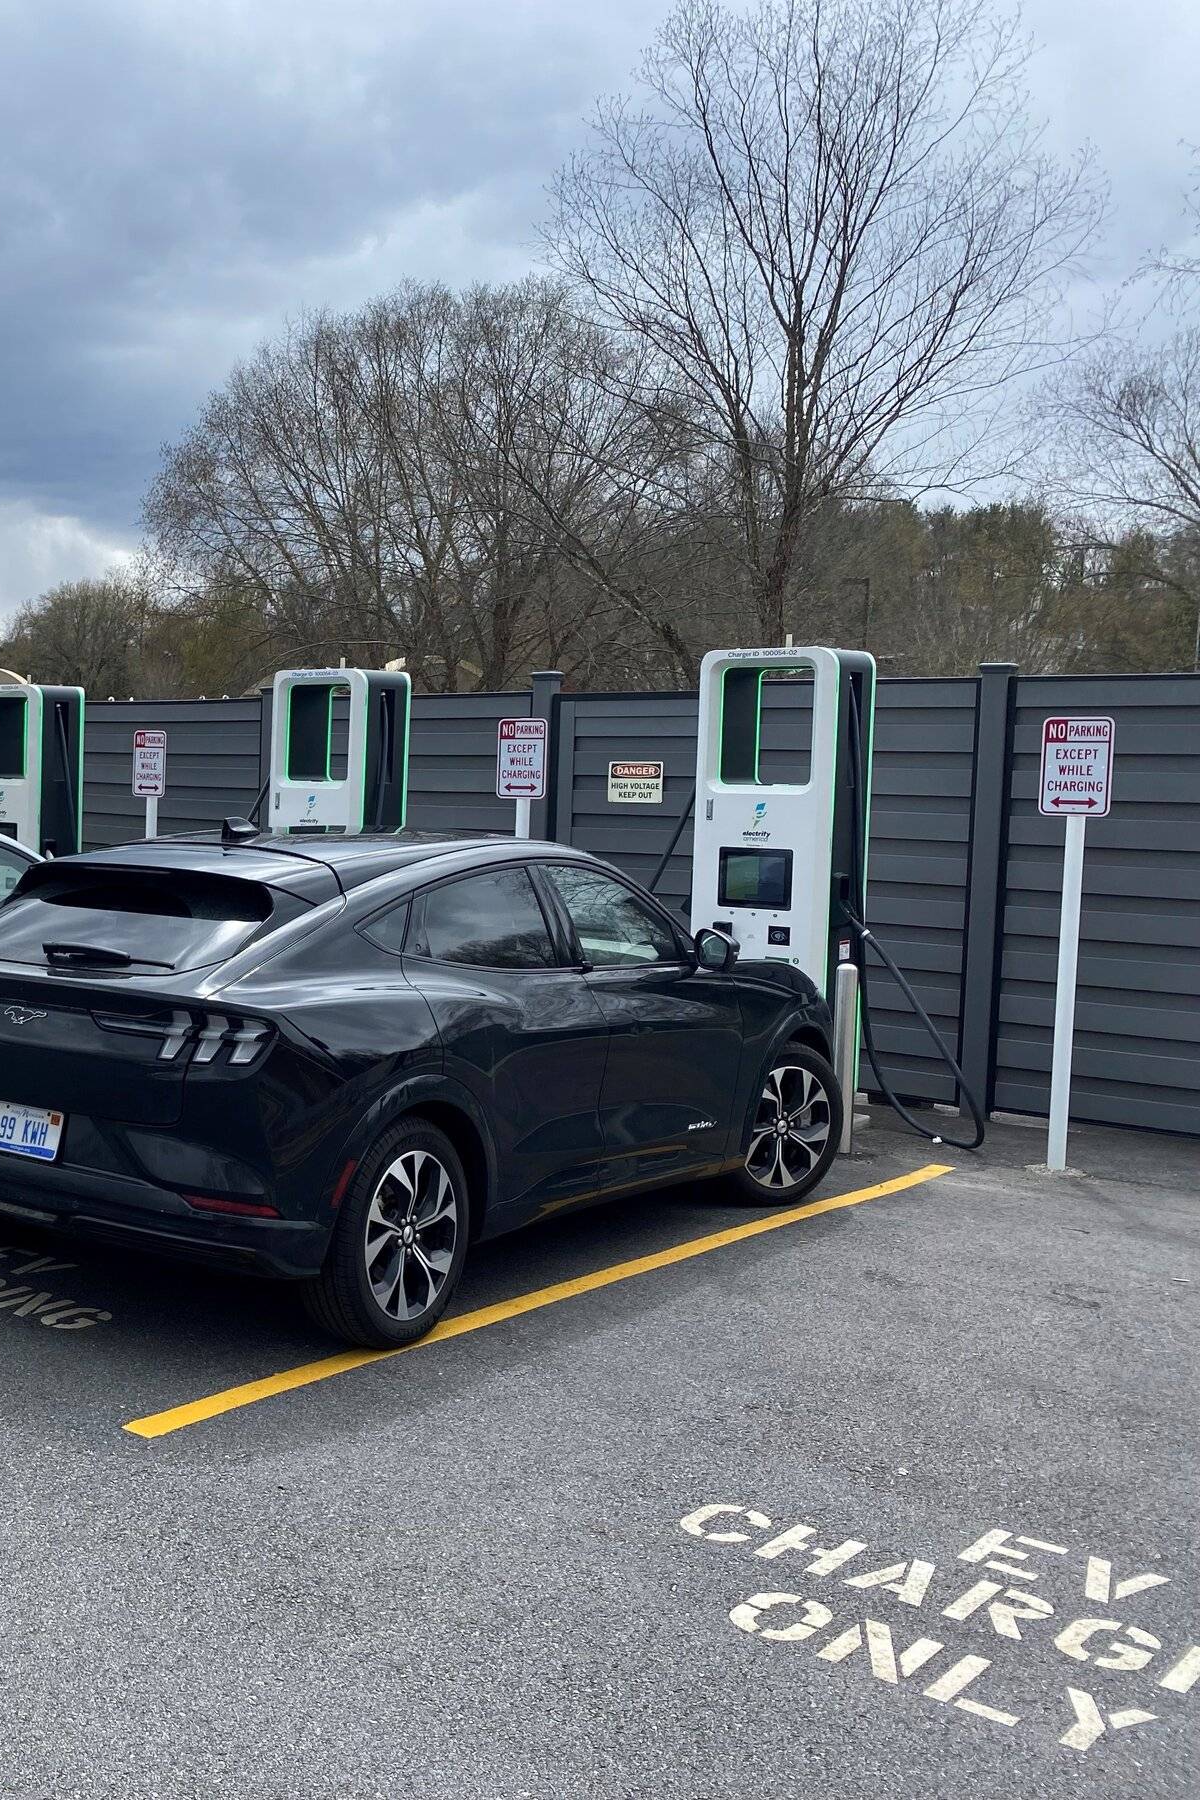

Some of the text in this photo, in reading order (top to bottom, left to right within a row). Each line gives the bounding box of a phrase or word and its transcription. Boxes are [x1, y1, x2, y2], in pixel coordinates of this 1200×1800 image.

[728, 651, 752, 659] Charger
[502, 723, 544, 737] NO PARKING
[1048, 723, 1109, 739] NO PARKING
[136, 734, 144, 745] NO
[507, 744, 537, 754] EXCEPT
[1055, 748, 1099, 760] EXCEPT
[140, 751, 160, 760] EXCEPT
[141, 762, 157, 770] WHILE
[509, 757, 533, 766] WHILE
[502, 769, 541, 780] CHARGING
[616, 766, 656, 775] DANGER
[1058, 764, 1094, 777] WHILE
[136, 772, 162, 781] CHARGING
[611, 782, 660, 790] HIGH VOLTAGE
[1047, 780, 1103, 792] CHARGING
[618, 791, 653, 799] KEEP OUT
[742, 830, 771, 838] electrify
[21, 1119, 50, 1147] KWH
[957, 1528, 1173, 1604] EV
[728, 1591, 1160, 1752] ONLY
